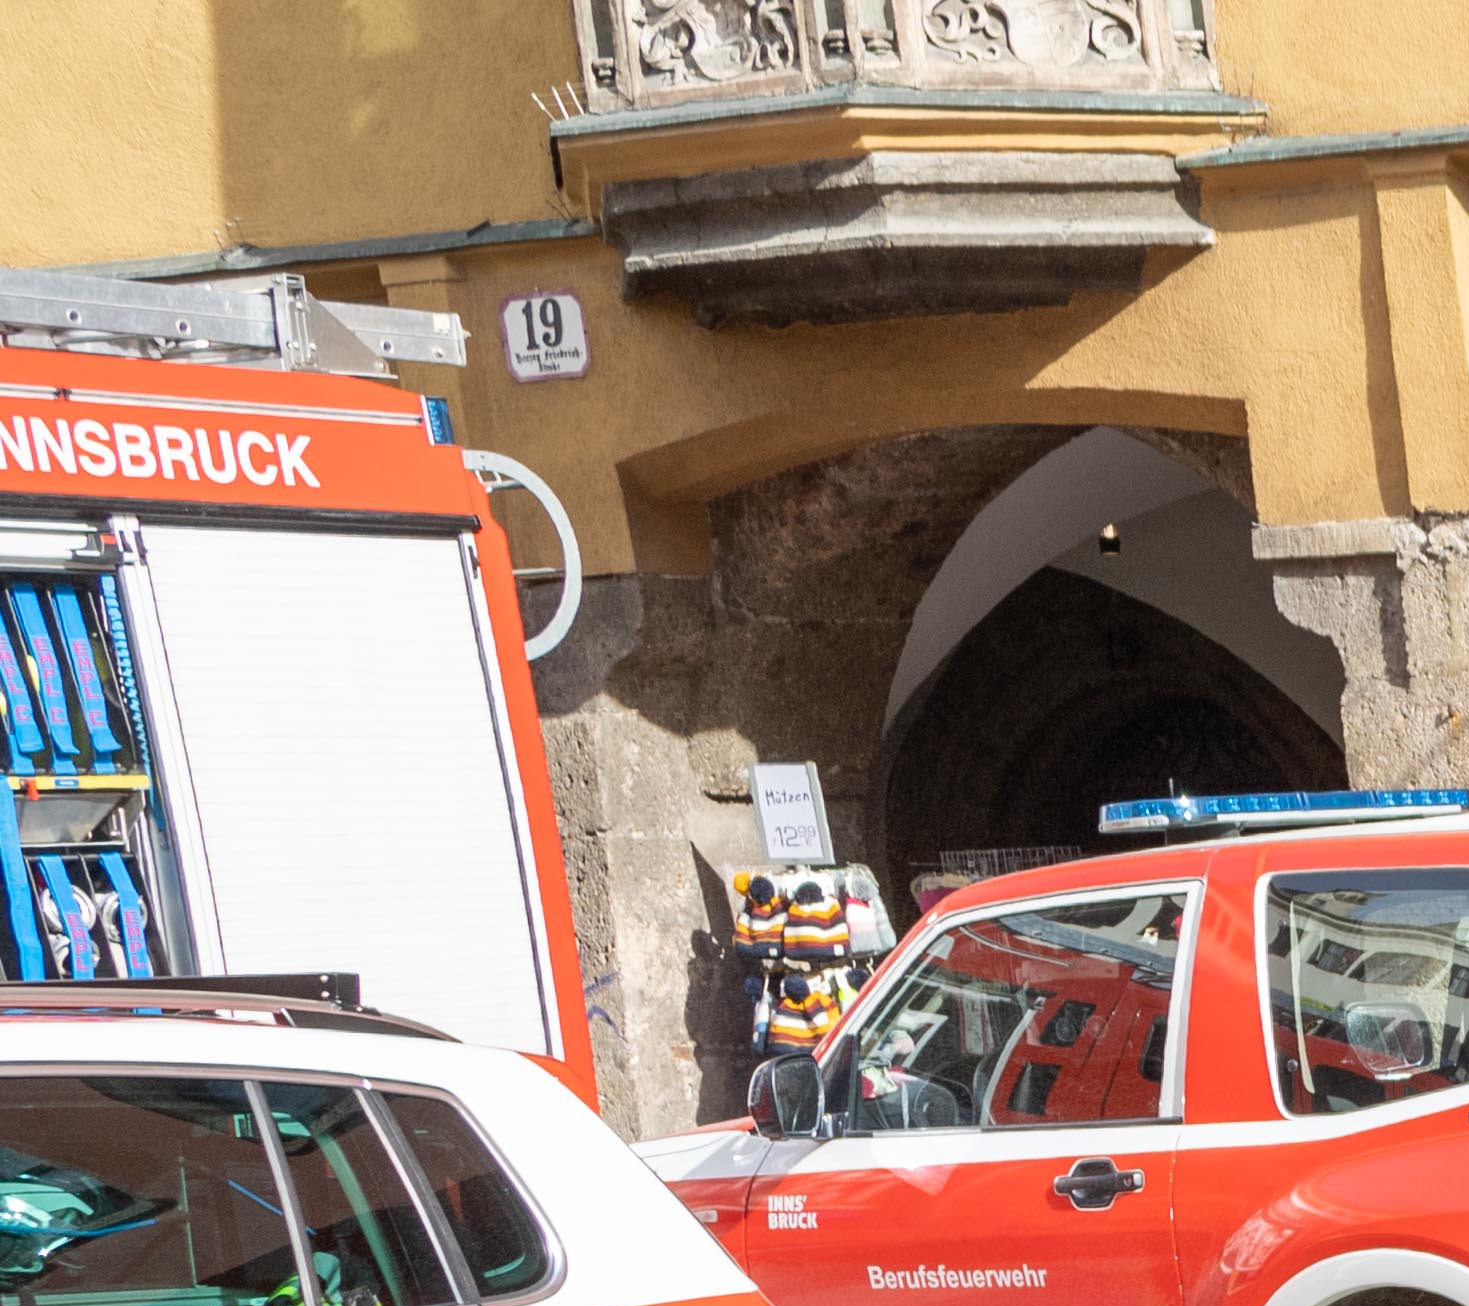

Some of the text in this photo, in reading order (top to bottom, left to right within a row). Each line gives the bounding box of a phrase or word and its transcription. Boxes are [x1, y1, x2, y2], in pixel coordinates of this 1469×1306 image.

[521, 298, 563, 350] 19
[0, 416, 321, 488] NNSBRUCK
[768, 1212, 819, 1230] BRUCK
[867, 1264, 1048, 1290] Berufsfeuerwehr
